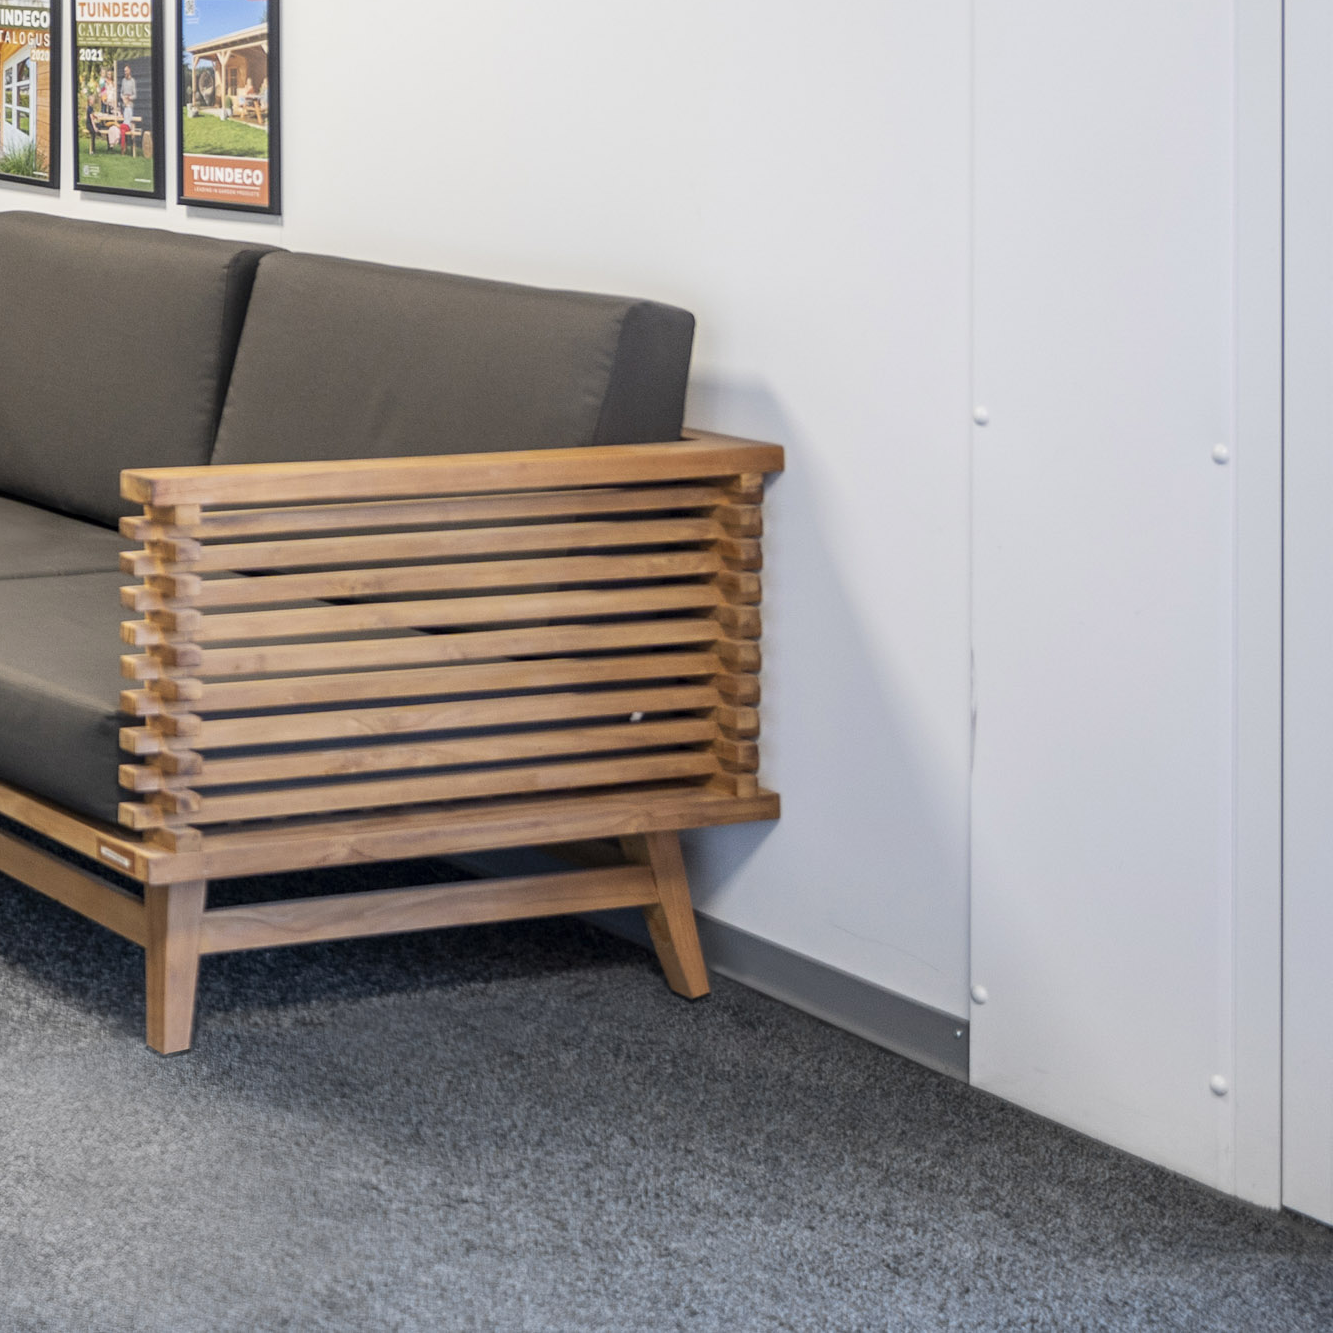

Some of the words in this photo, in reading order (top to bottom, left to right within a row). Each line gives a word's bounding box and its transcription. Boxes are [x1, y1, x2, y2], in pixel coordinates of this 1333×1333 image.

[78, 2, 150, 18] TUINDECO
[78, 22, 151, 38] CATALOGUS
[30, 48, 50, 62] 2020
[79, 48, 104, 62] 2021
[190, 164, 264, 186] TUINDECO
